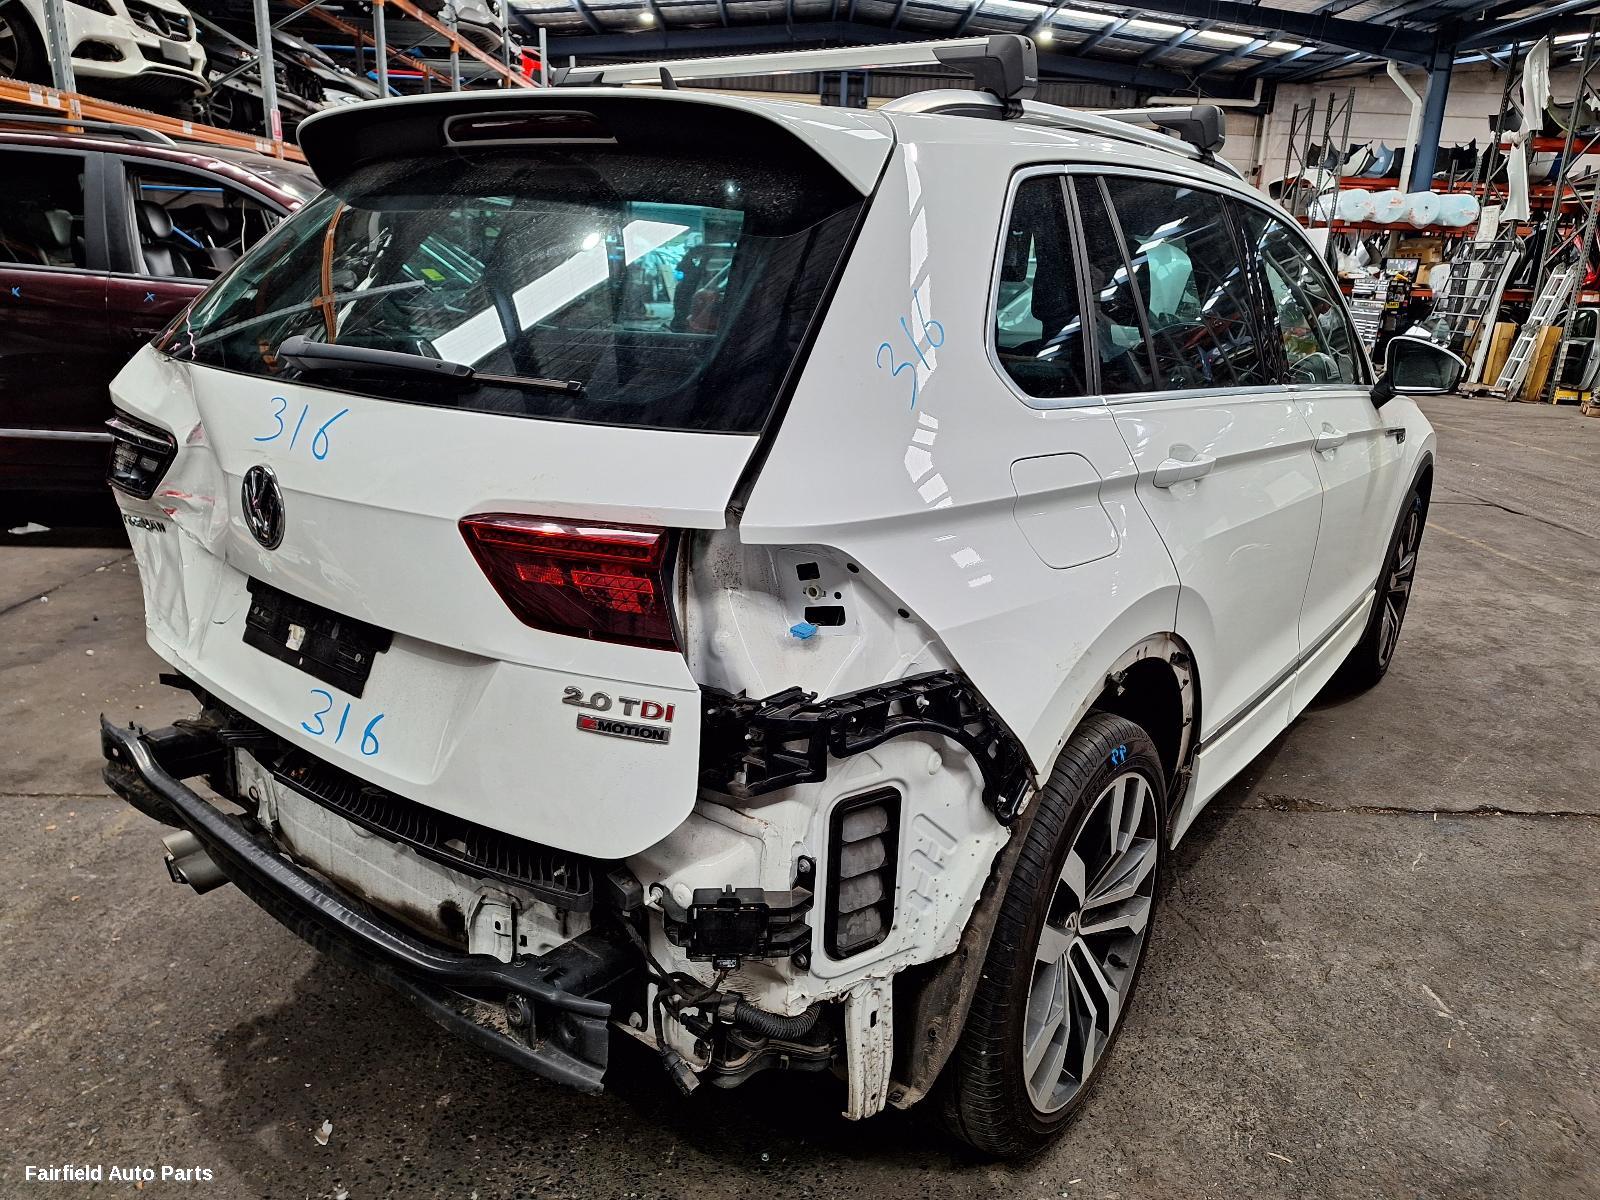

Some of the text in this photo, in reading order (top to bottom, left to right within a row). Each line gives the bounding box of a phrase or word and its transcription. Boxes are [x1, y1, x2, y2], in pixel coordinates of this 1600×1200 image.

[877, 288, 945, 410] 316
[255, 397, 348, 461] 316
[301, 688, 384, 756] 316
[618, 695, 676, 723] TDI
